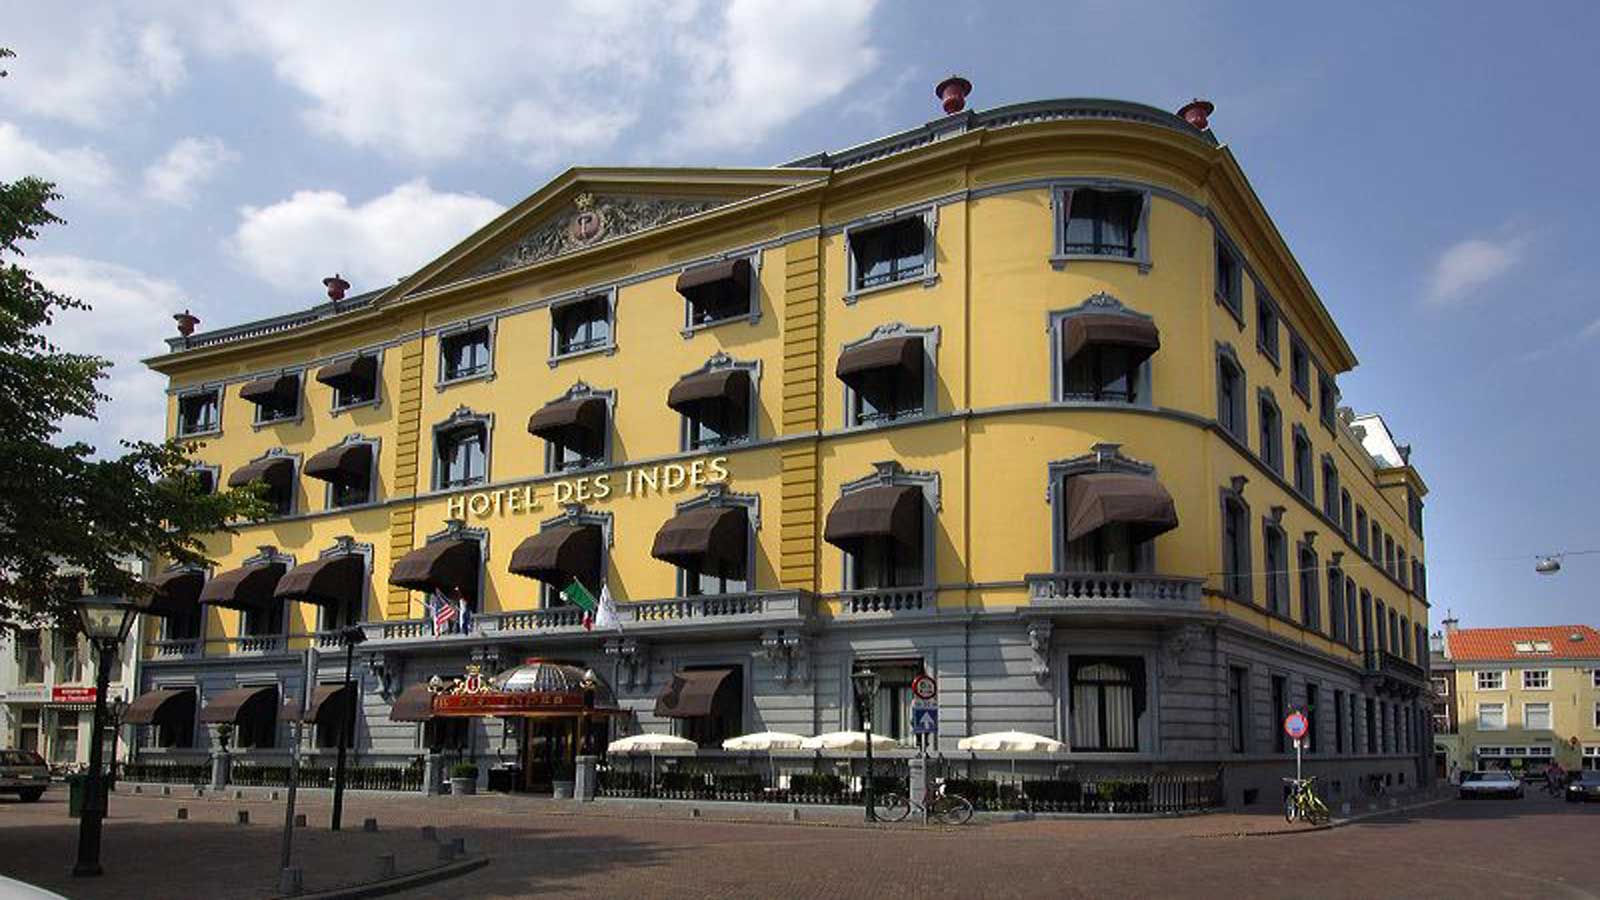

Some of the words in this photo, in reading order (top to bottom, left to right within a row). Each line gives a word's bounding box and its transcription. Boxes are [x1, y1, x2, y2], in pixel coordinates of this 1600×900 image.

[447, 485, 540, 518] HOTEL
[554, 474, 611, 503] DES
[626, 457, 729, 494] INDES
